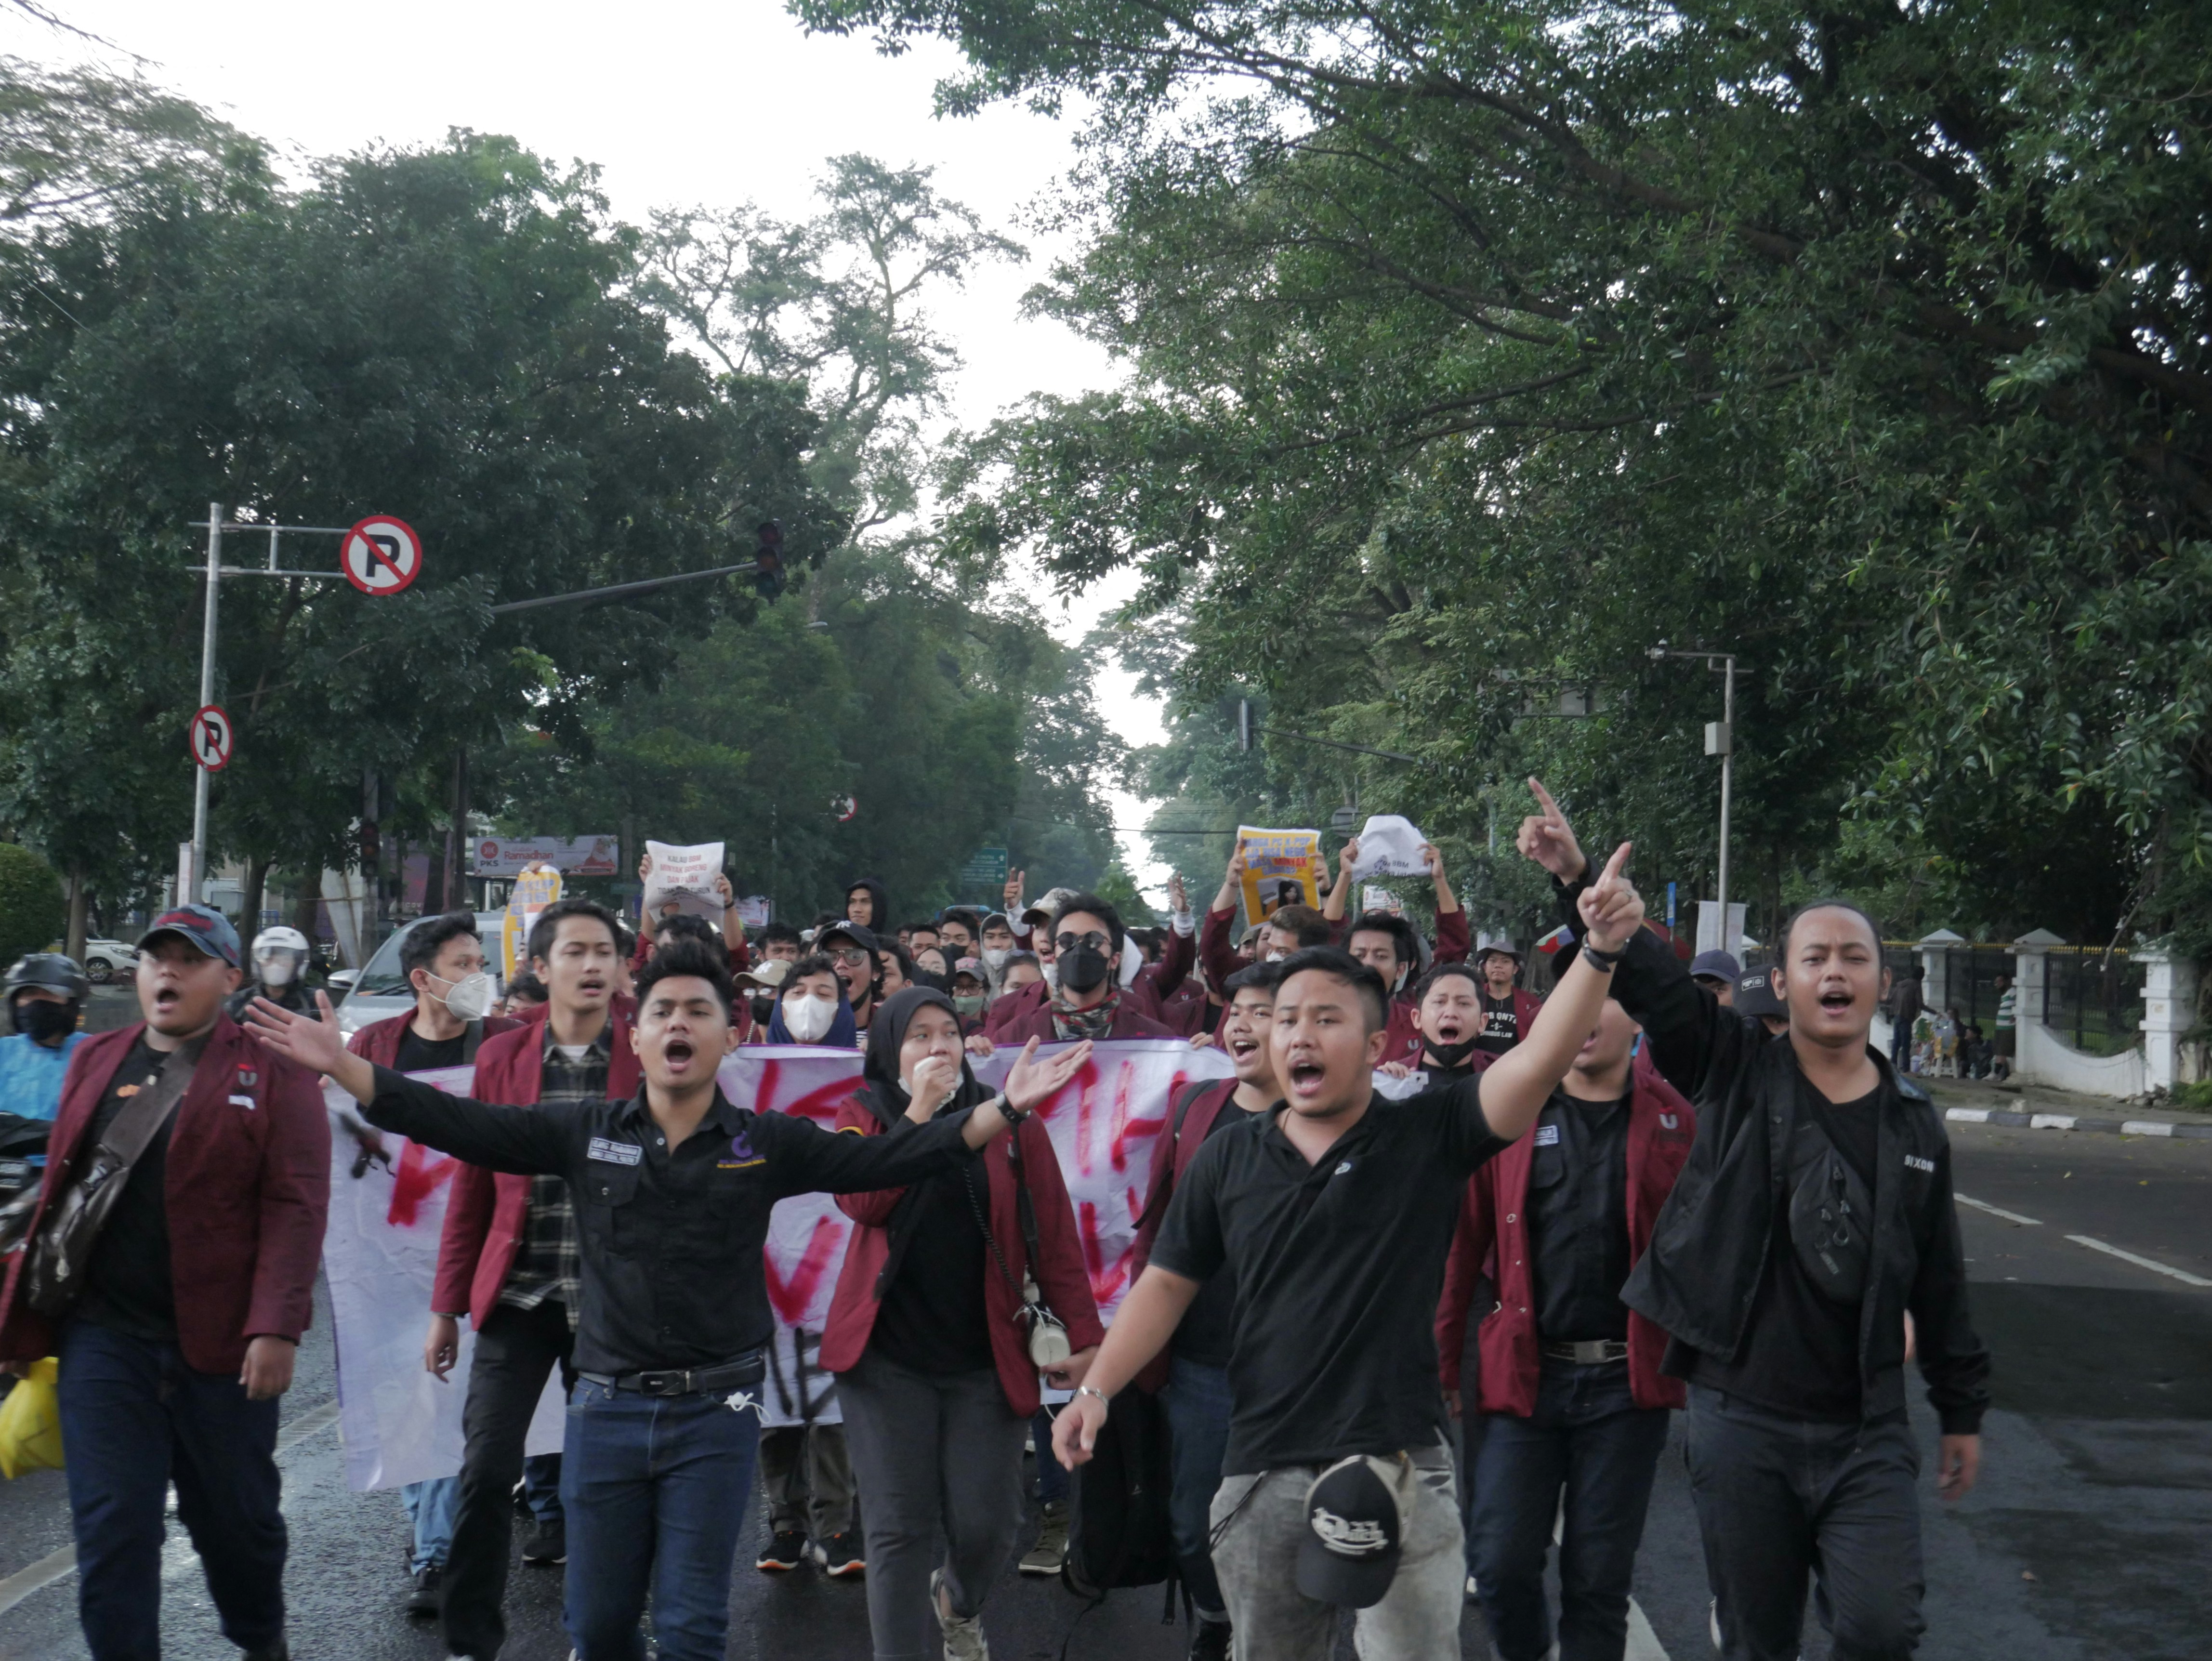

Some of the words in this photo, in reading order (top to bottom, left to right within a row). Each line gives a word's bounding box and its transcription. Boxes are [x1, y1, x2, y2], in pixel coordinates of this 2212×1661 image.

[366, 534, 400, 578] P
[203, 720, 222, 757] P
[504, 850, 553, 860] Ramadhan
[1274, 857, 1307, 867] MINYAK
[660, 864, 683, 873] MINYAK
[684, 864, 707, 872] GORENG
